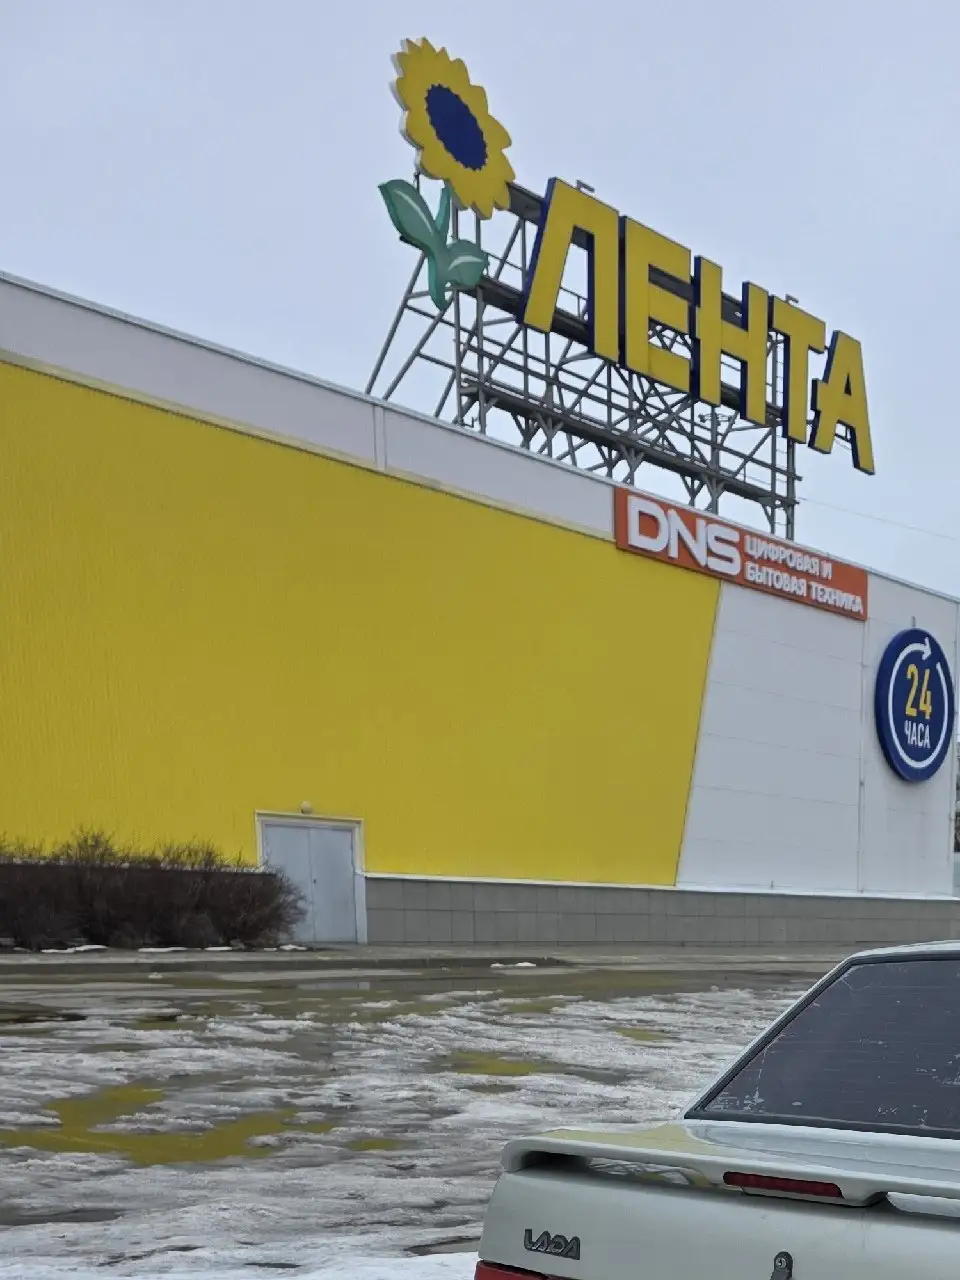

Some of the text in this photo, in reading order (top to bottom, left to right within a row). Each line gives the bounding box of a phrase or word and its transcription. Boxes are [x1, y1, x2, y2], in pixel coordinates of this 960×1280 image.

[521, 176, 875, 475] ЛЕНТА
[627, 494, 741, 576] DNS
[744, 534, 833, 580] ЦИФРОВАЯ И
[744, 561, 864, 614] БЫТОВАЯ ТЕХНИКА
[905, 663, 932, 720] 24
[903, 719, 931, 749] ЧАСА
[523, 1228, 581, 1261] LADA
